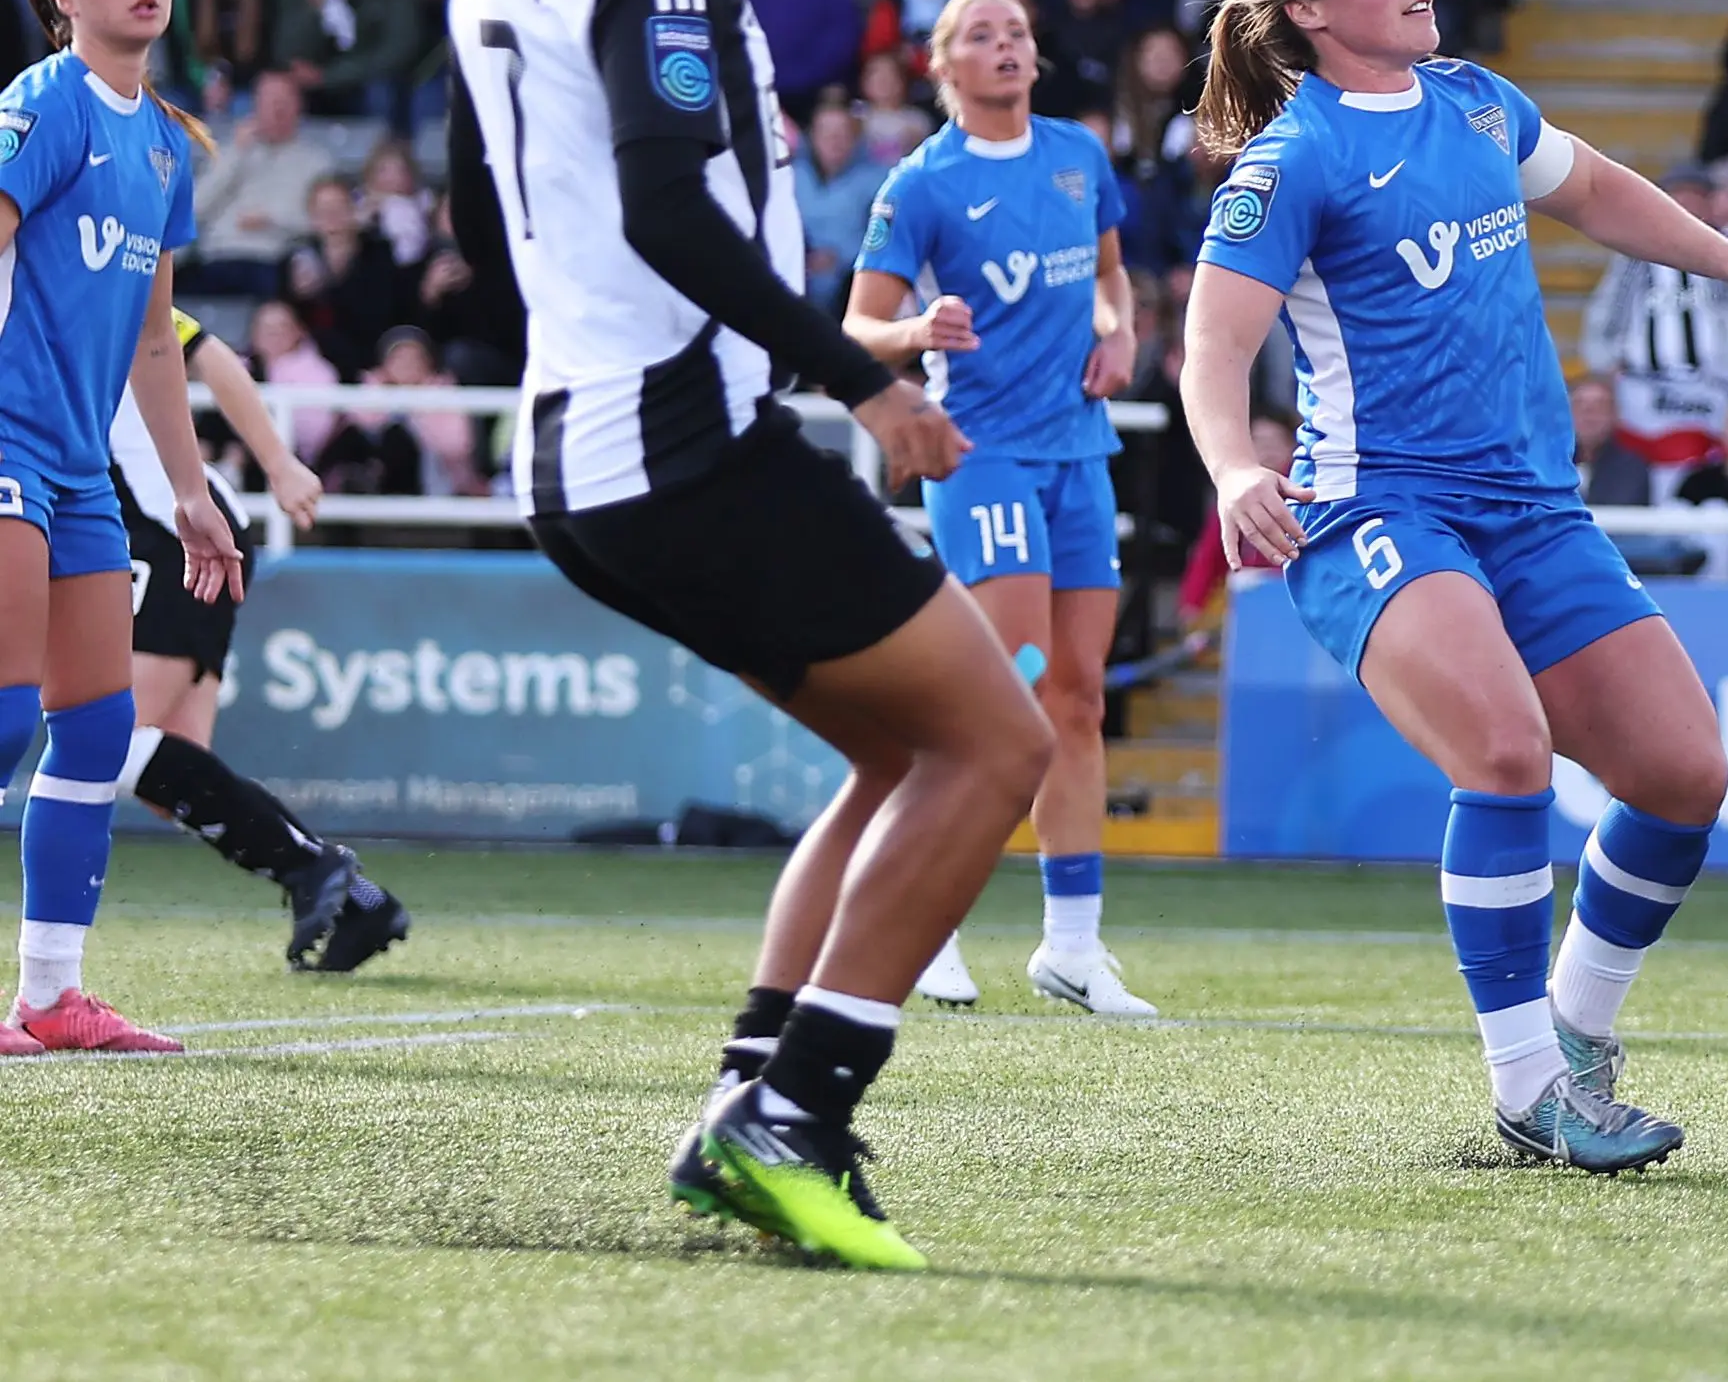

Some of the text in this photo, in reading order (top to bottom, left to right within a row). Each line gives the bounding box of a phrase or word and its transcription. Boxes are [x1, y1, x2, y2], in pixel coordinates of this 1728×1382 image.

[1465, 203, 1518, 239] VISION
[969, 501, 1029, 567] 14
[262, 628, 640, 731] Systems
